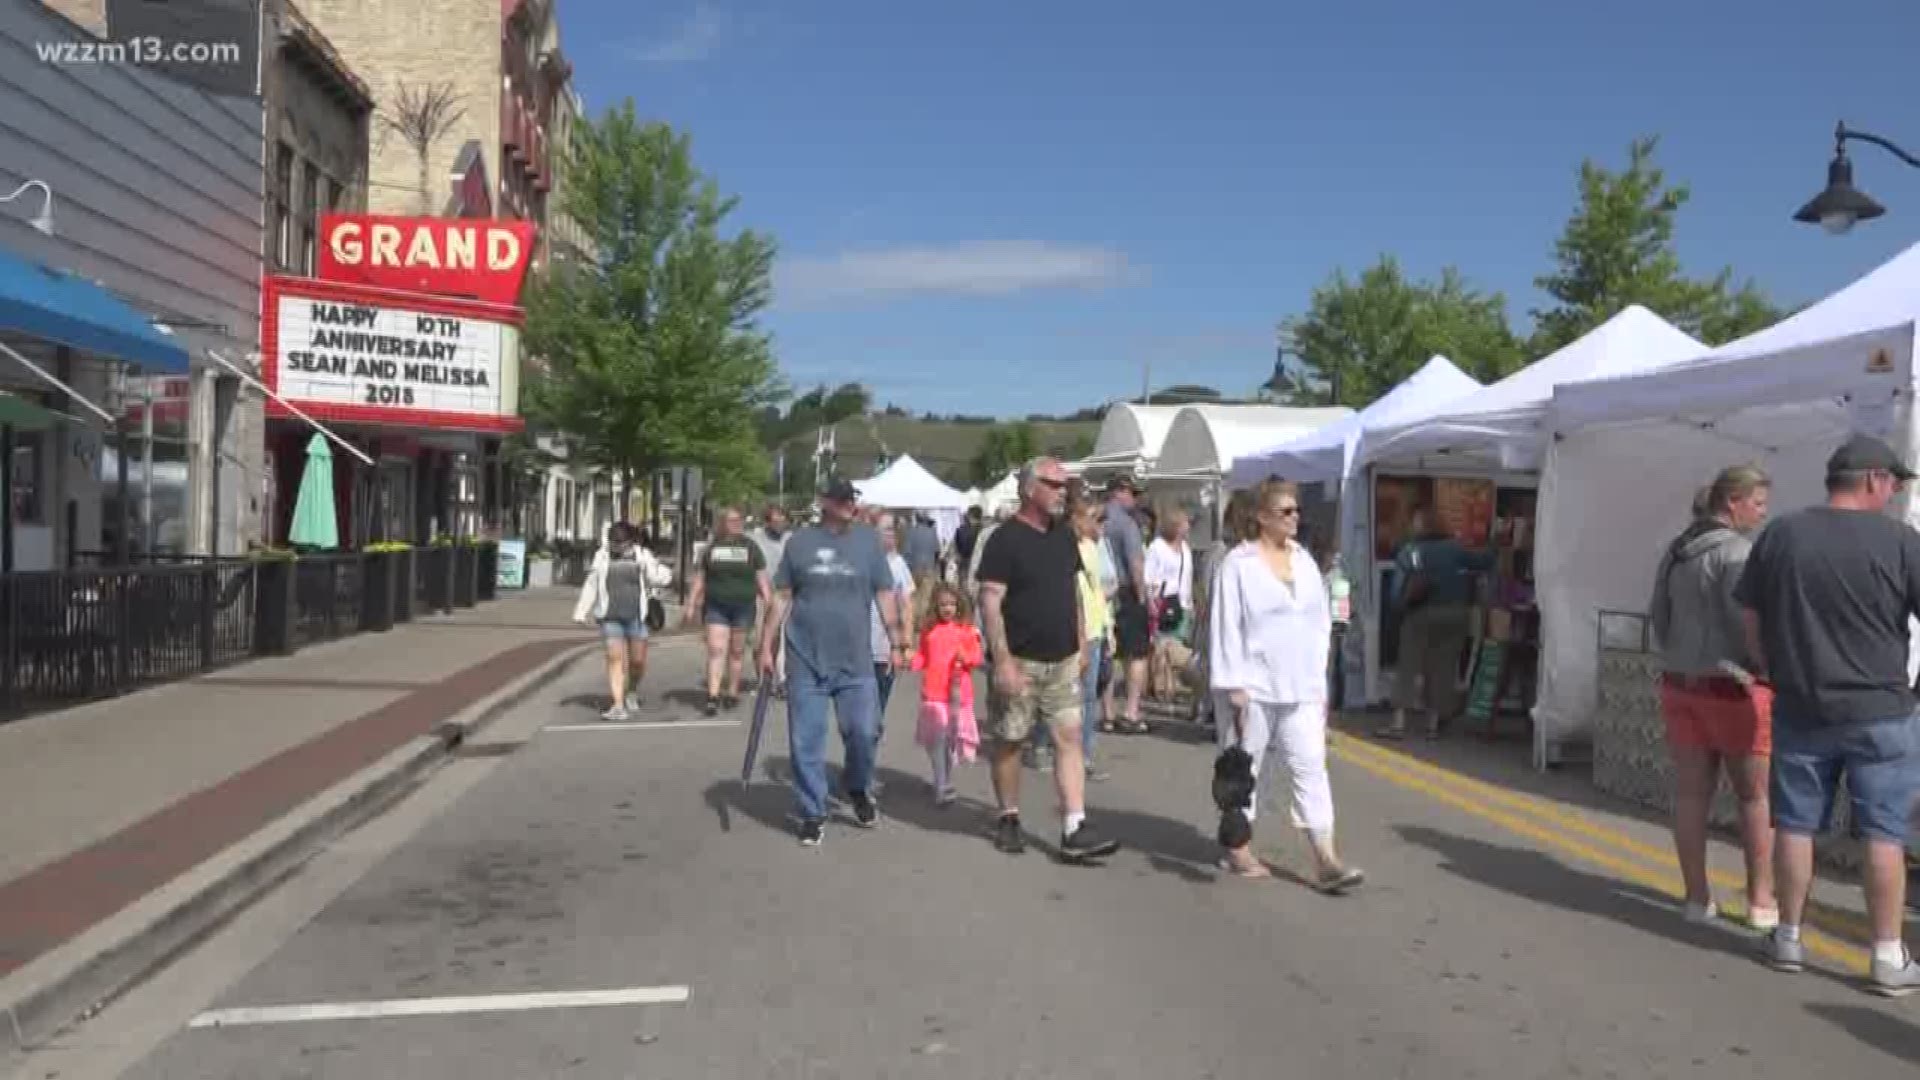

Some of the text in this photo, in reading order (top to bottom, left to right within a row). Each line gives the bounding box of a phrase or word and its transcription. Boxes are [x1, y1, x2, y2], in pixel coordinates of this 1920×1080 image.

[330, 222, 520, 271] GRAND
[311, 303, 461, 337] HAPPY 10TH
[311, 329, 457, 361] ANNIVERSARY
[287, 350, 490, 388] SEAN AND MELISSA
[365, 383, 414, 405] 2018
